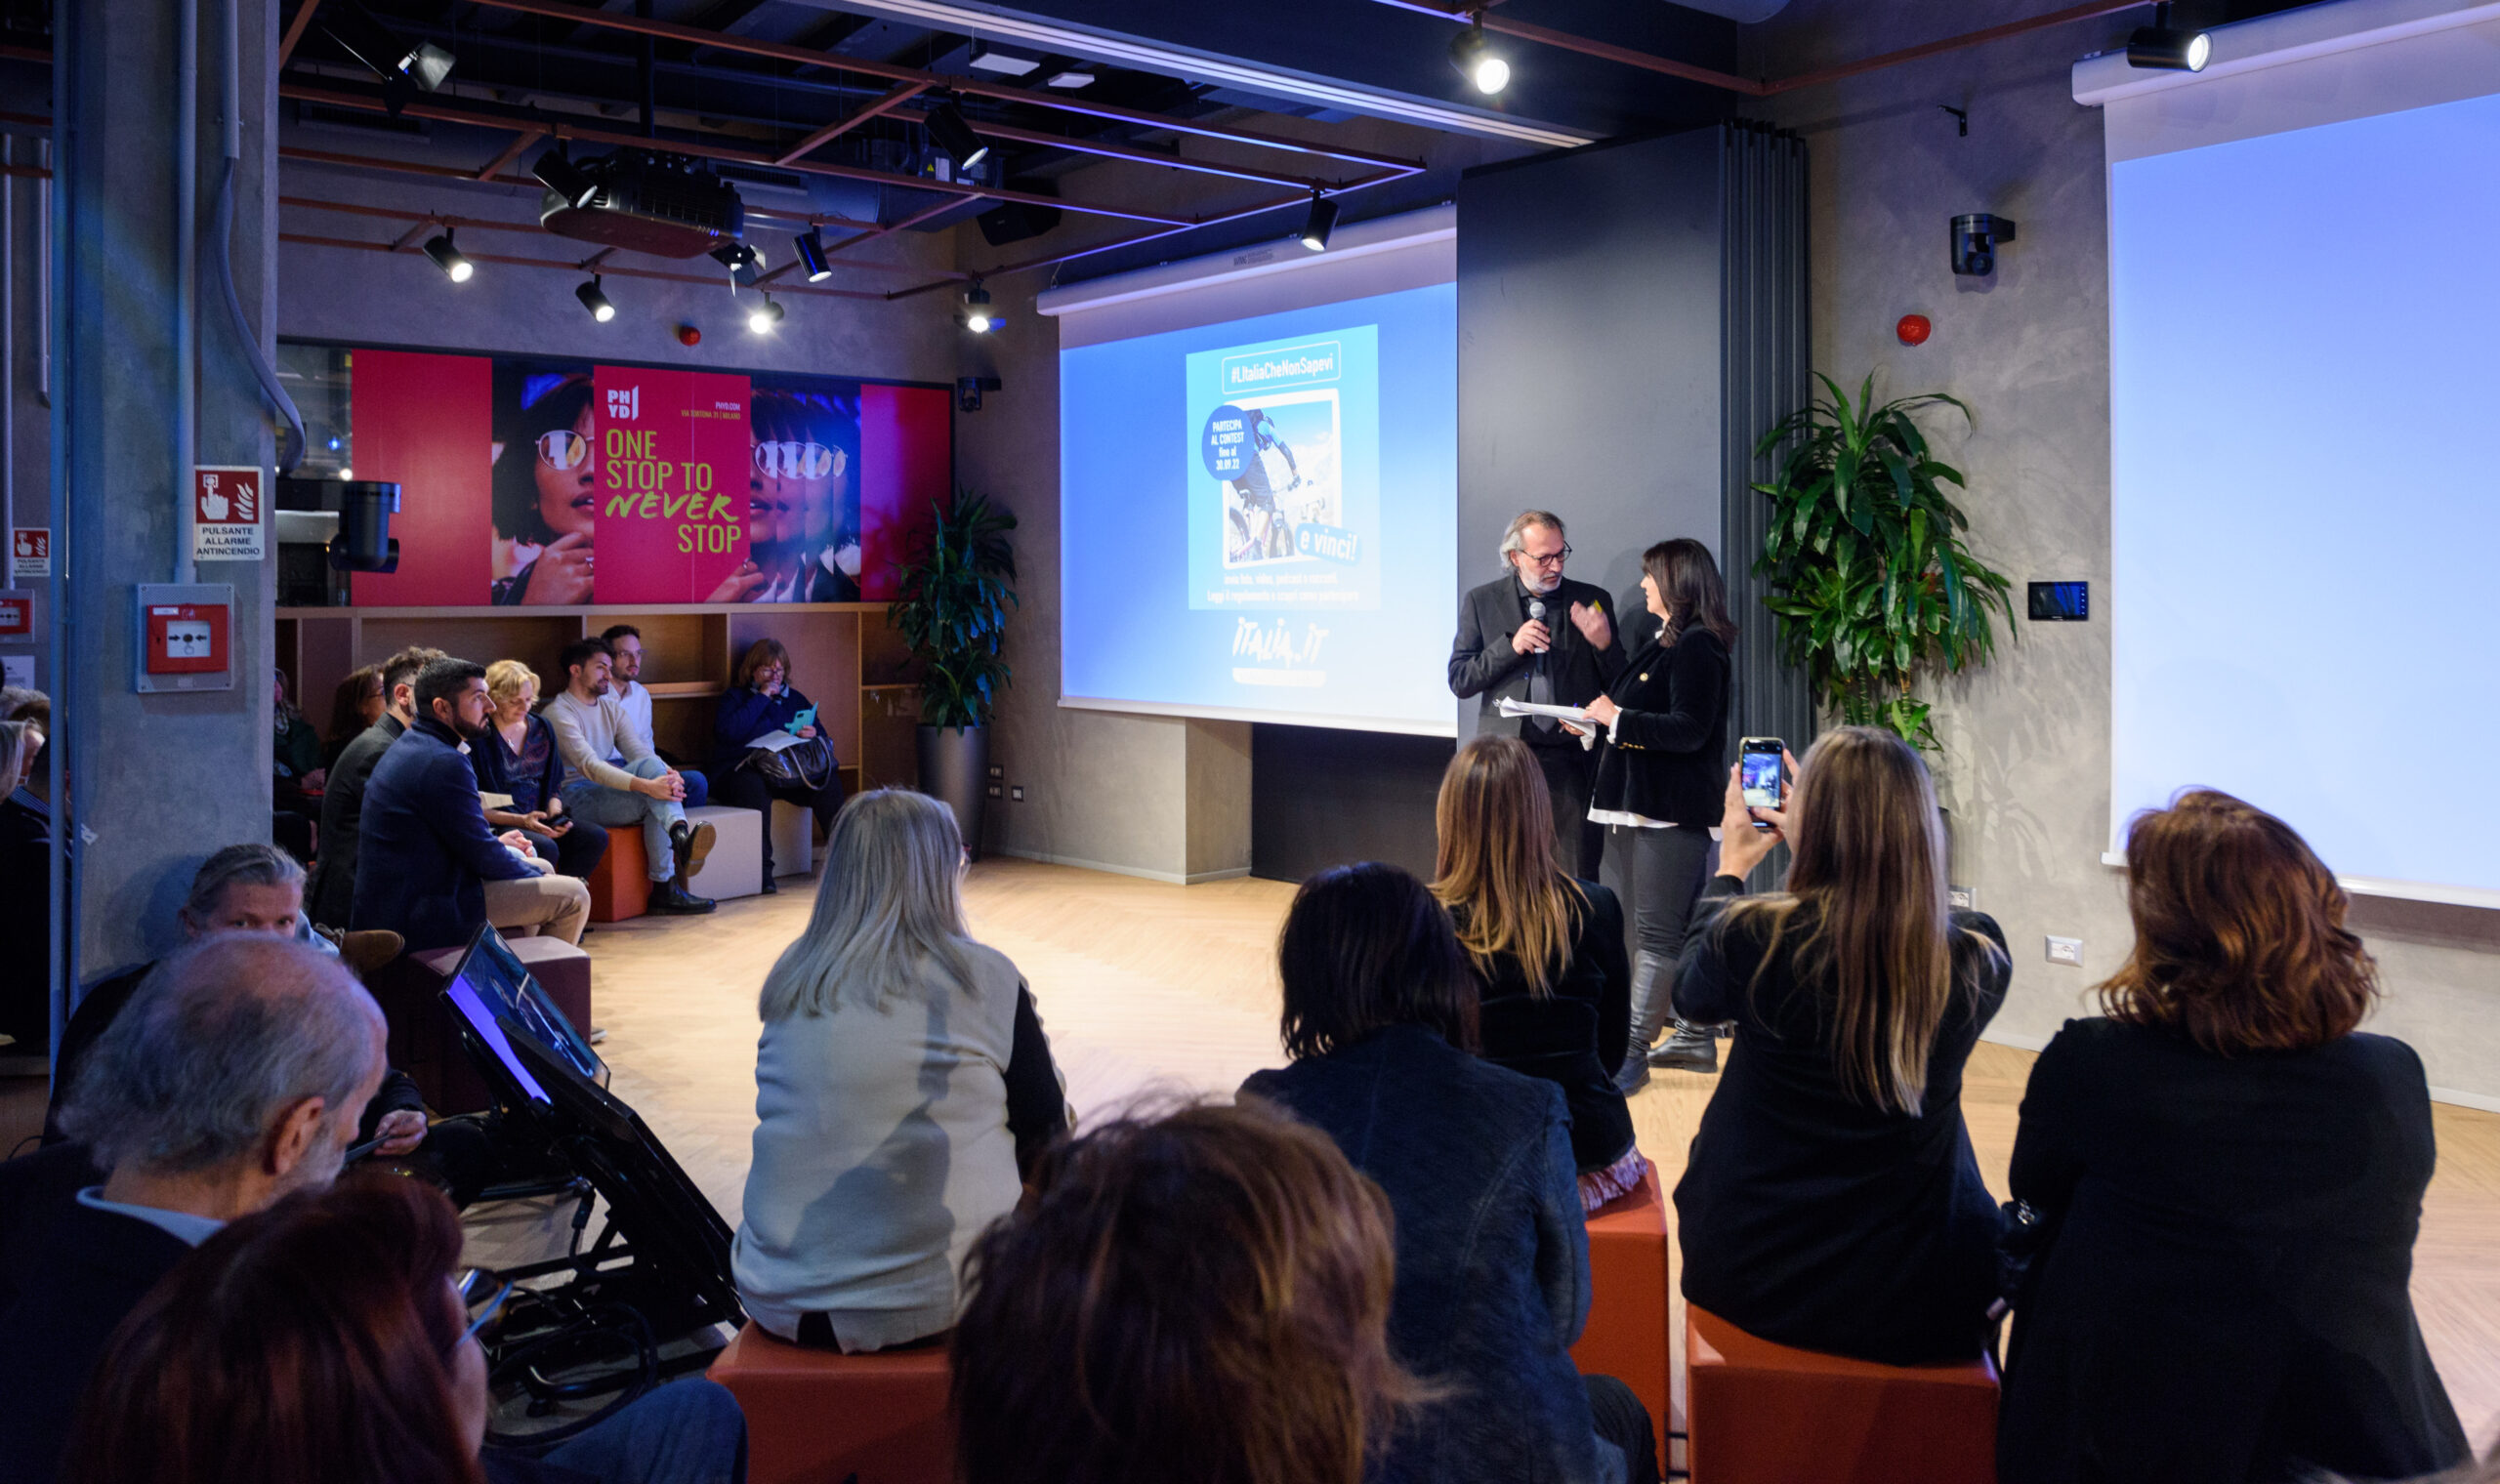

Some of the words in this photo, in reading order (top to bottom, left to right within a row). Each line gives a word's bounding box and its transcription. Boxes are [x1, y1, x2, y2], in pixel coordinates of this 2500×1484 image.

[1211, 434, 1219, 445] AL
[1220, 432, 1244, 445] CONTEST
[1212, 419, 1242, 433] PARTECIPA
[605, 429, 657, 460] ONE
[606, 460, 673, 489] STOP
[681, 462, 712, 491] TO
[605, 490, 739, 522] NEVER
[678, 524, 741, 553] STOP
[1300, 530, 1311, 551] e
[1314, 527, 1357, 561] vinci!
